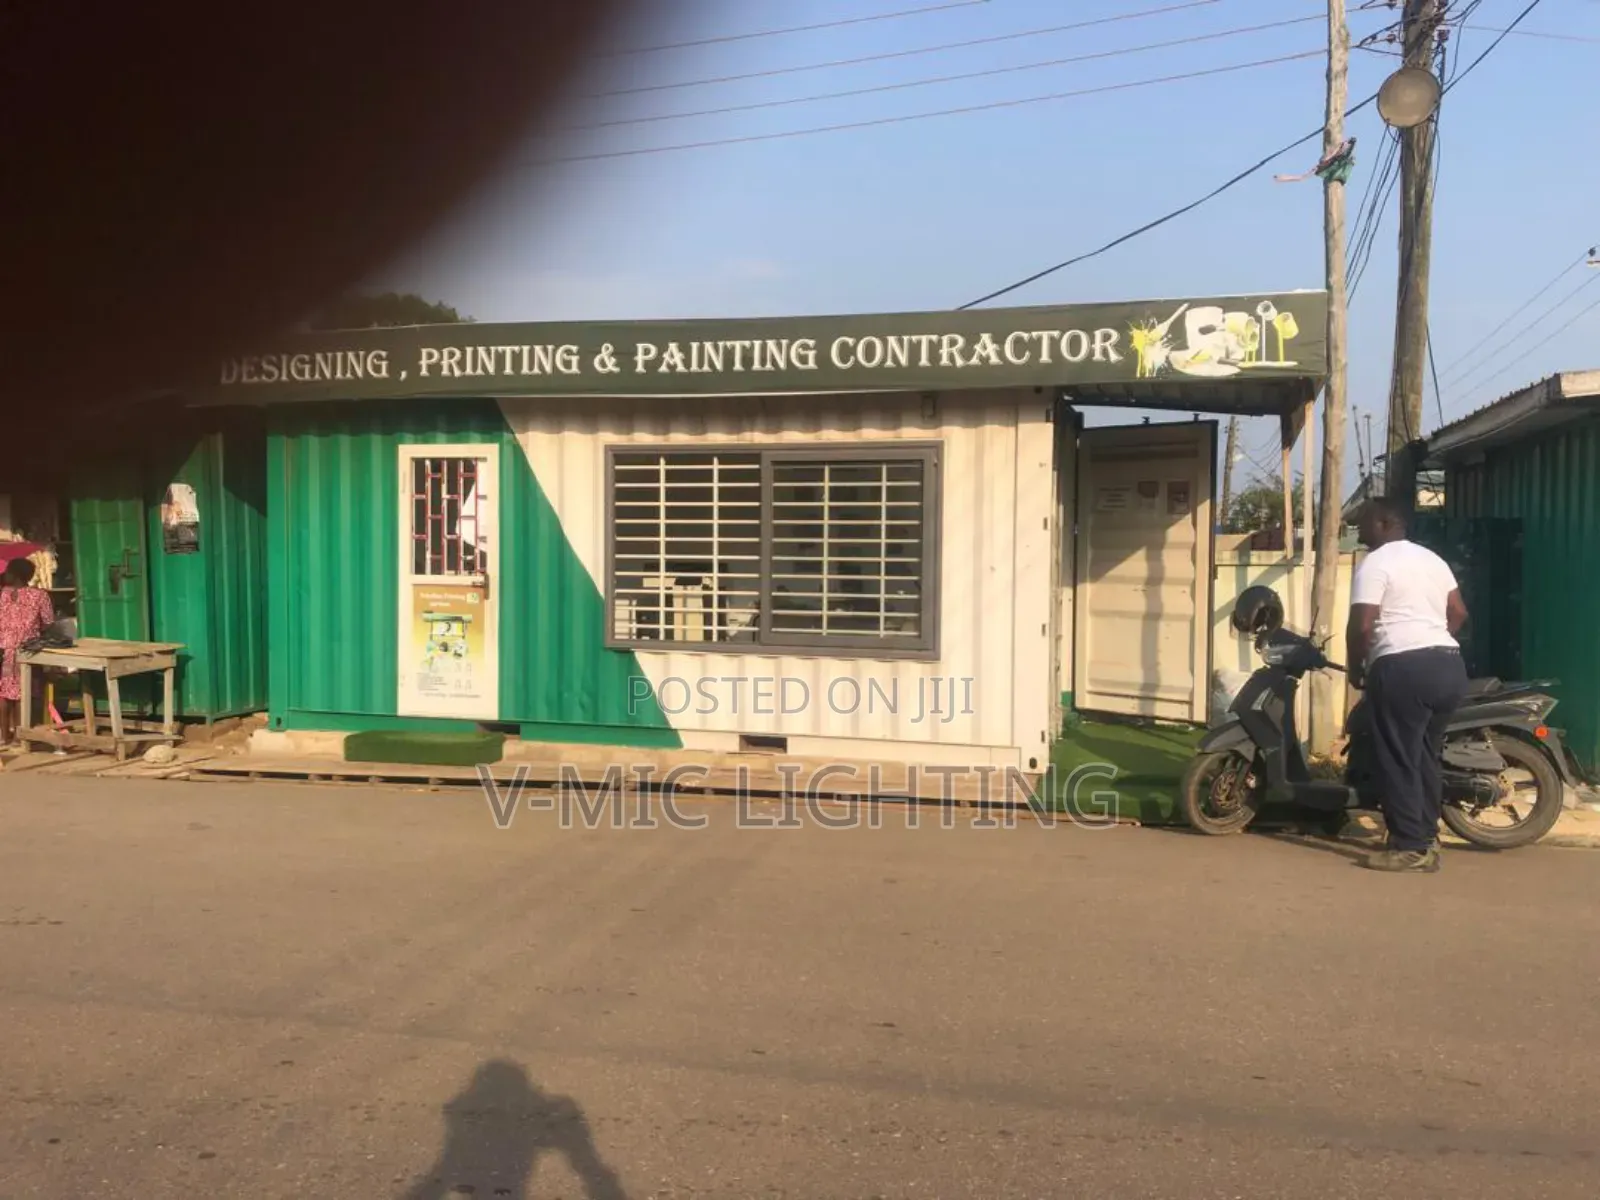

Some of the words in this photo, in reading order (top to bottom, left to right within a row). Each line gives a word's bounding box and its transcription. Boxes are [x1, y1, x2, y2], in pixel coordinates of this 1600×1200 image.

[220, 350, 389, 384] DESIGNING
[418, 343, 580, 378] PRINTING
[593, 342, 620, 373] &
[633, 337, 819, 374] PAINTING
[829, 327, 1123, 370] CONTRACTOR
